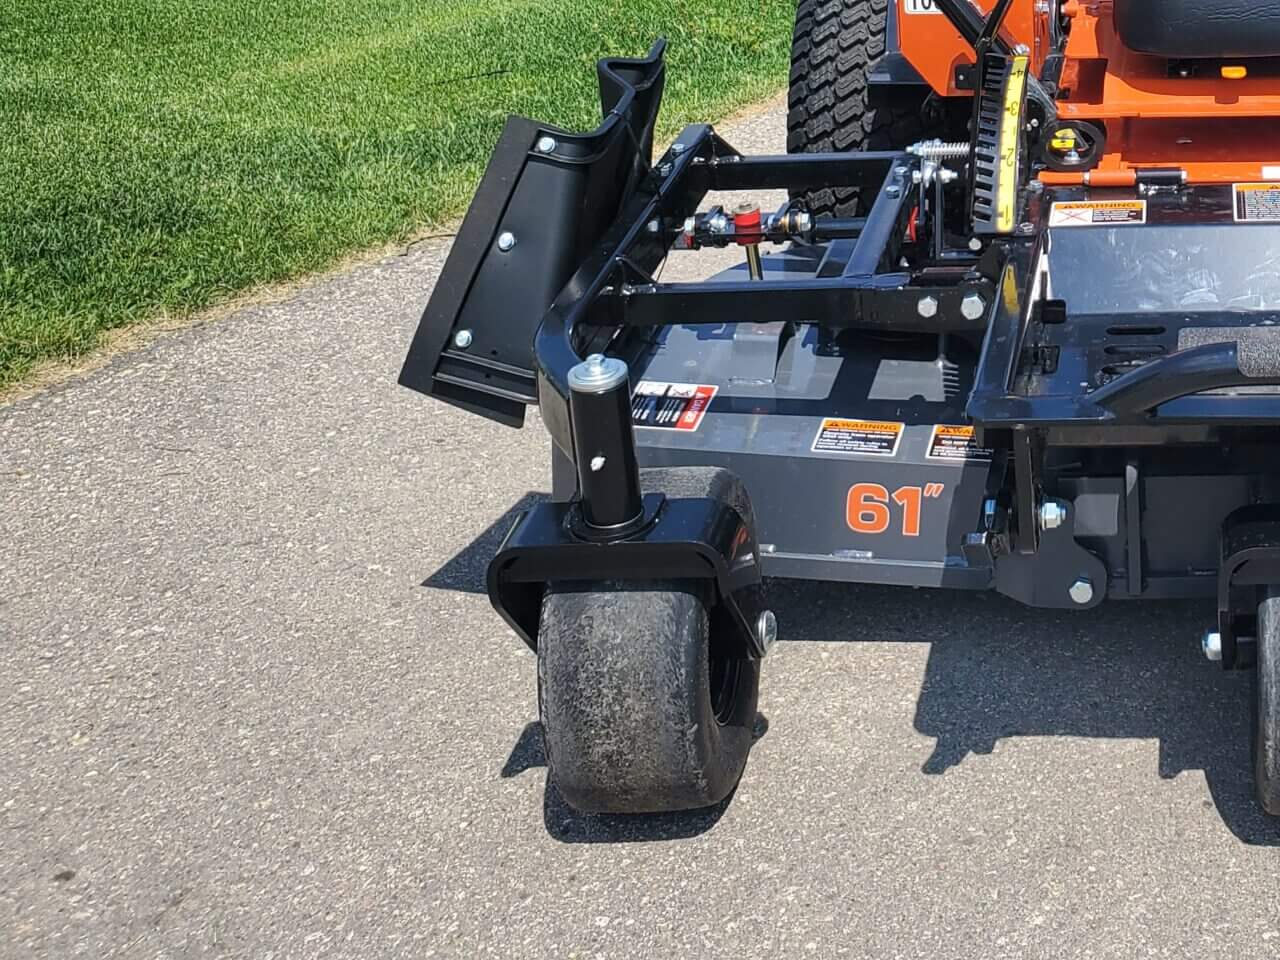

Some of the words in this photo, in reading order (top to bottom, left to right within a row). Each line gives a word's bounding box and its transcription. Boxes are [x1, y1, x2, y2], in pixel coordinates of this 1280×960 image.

[1010, 101, 1018, 117] 3
[1006, 148, 1014, 167] 2
[842, 421, 898, 431] WARNING
[846, 483, 944, 536] 61"
